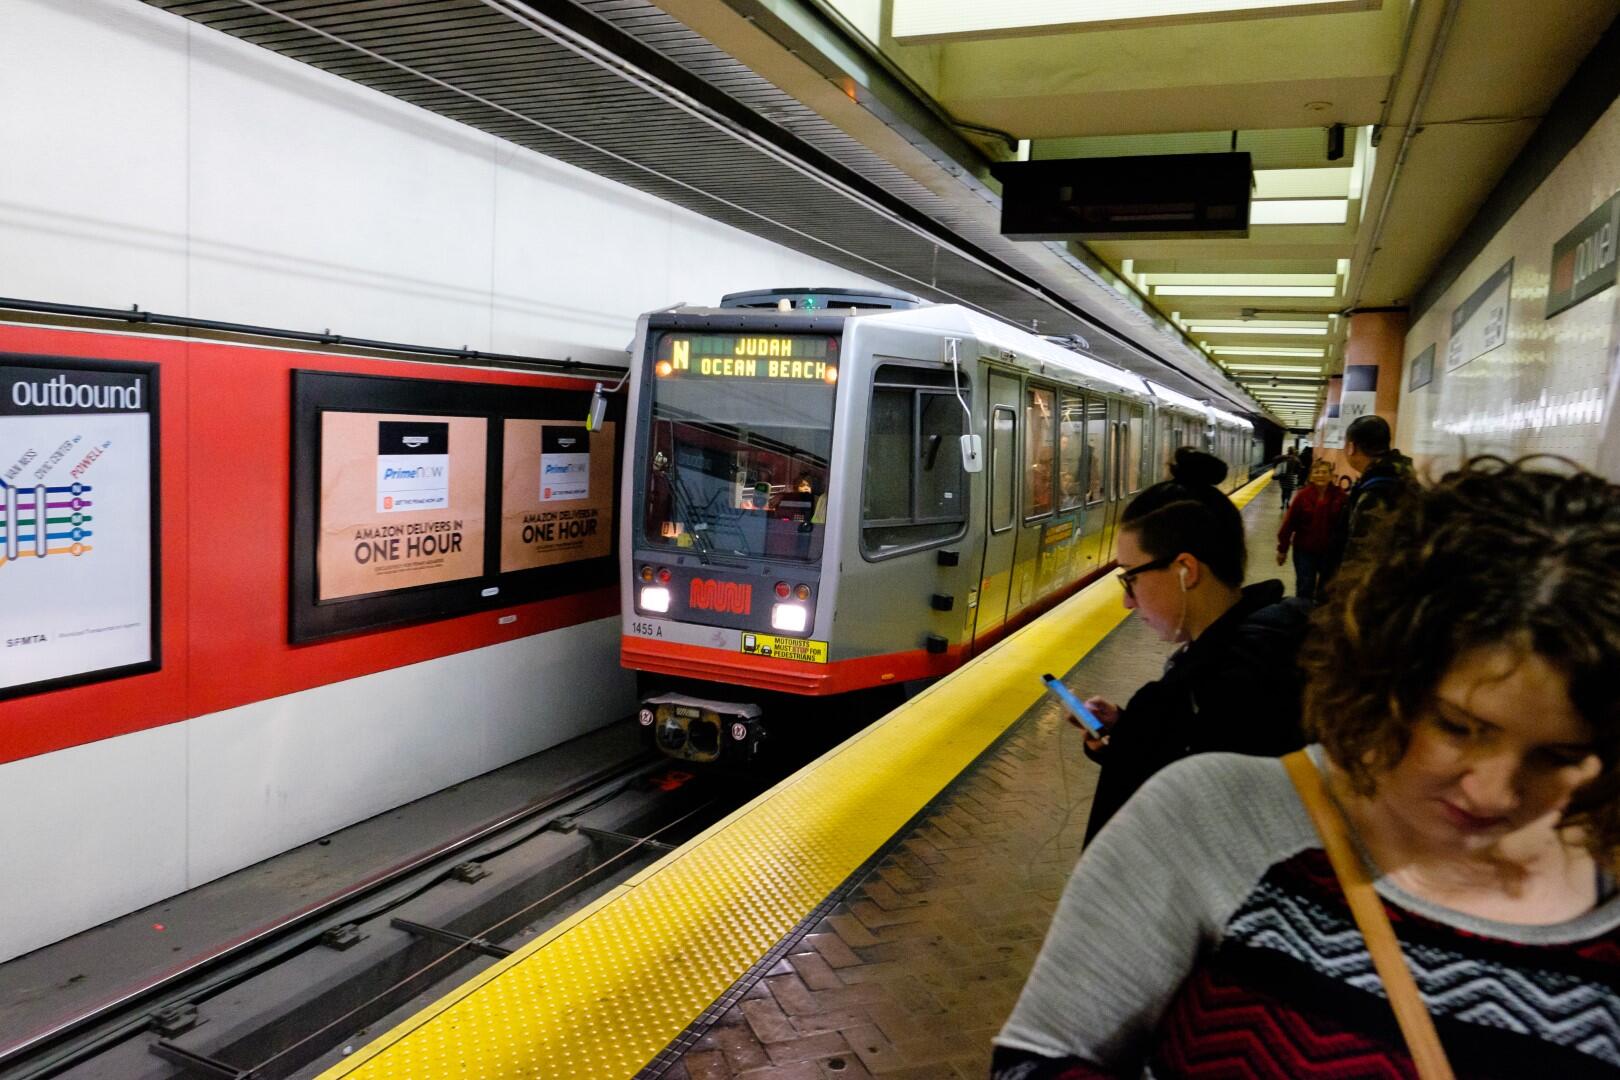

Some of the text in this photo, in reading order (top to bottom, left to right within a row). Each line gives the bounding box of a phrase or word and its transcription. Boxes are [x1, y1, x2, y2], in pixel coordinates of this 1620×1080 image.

[673, 338, 792, 369] N JUDAH
[701, 358, 826, 379] OCEAN BEACH
[12, 374, 141, 409] outbound
[70, 446, 104, 479] POWELL
[522, 512, 557, 524] AMAZON
[559, 509, 592, 521] DELIVERS
[354, 519, 464, 541] AMAZON DELIVERS IN
[522, 518, 598, 544] ONE HOUR
[354, 538, 400, 565] ONE
[407, 532, 463, 559] HOUR
[632, 622, 663, 637] 1455 A
[774, 638, 810, 648] MOTORISTS
[774, 644, 791, 652] MUST
[810, 648, 822, 656] FOR
[773, 650, 816, 662] PEDESTRIANS
